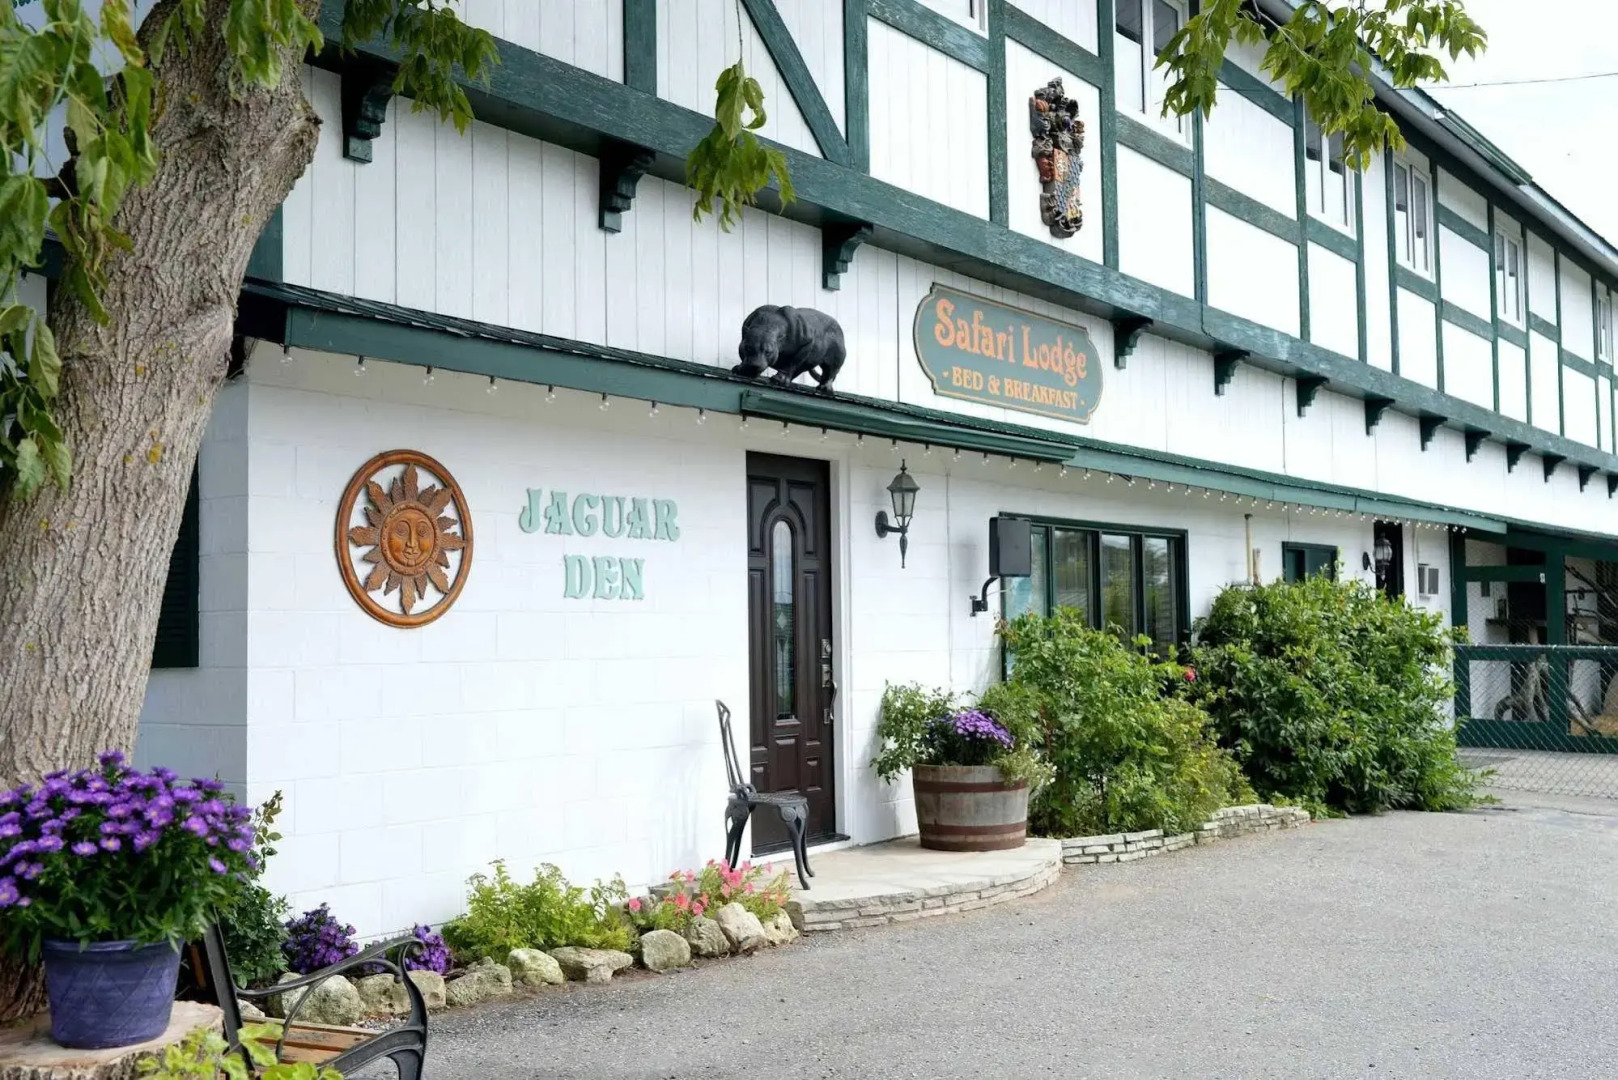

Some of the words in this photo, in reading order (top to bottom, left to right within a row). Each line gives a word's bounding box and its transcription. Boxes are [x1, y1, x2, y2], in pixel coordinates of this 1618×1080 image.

[934, 298, 1015, 363] Safari
[1021, 324, 1088, 387] Lodge
[952, 366, 983, 391] BED
[987, 375, 1000, 395] &
[1004, 377, 1078, 410] BREAKFAST
[518, 487, 681, 542] JAGUAR
[563, 553, 646, 600] DEN
